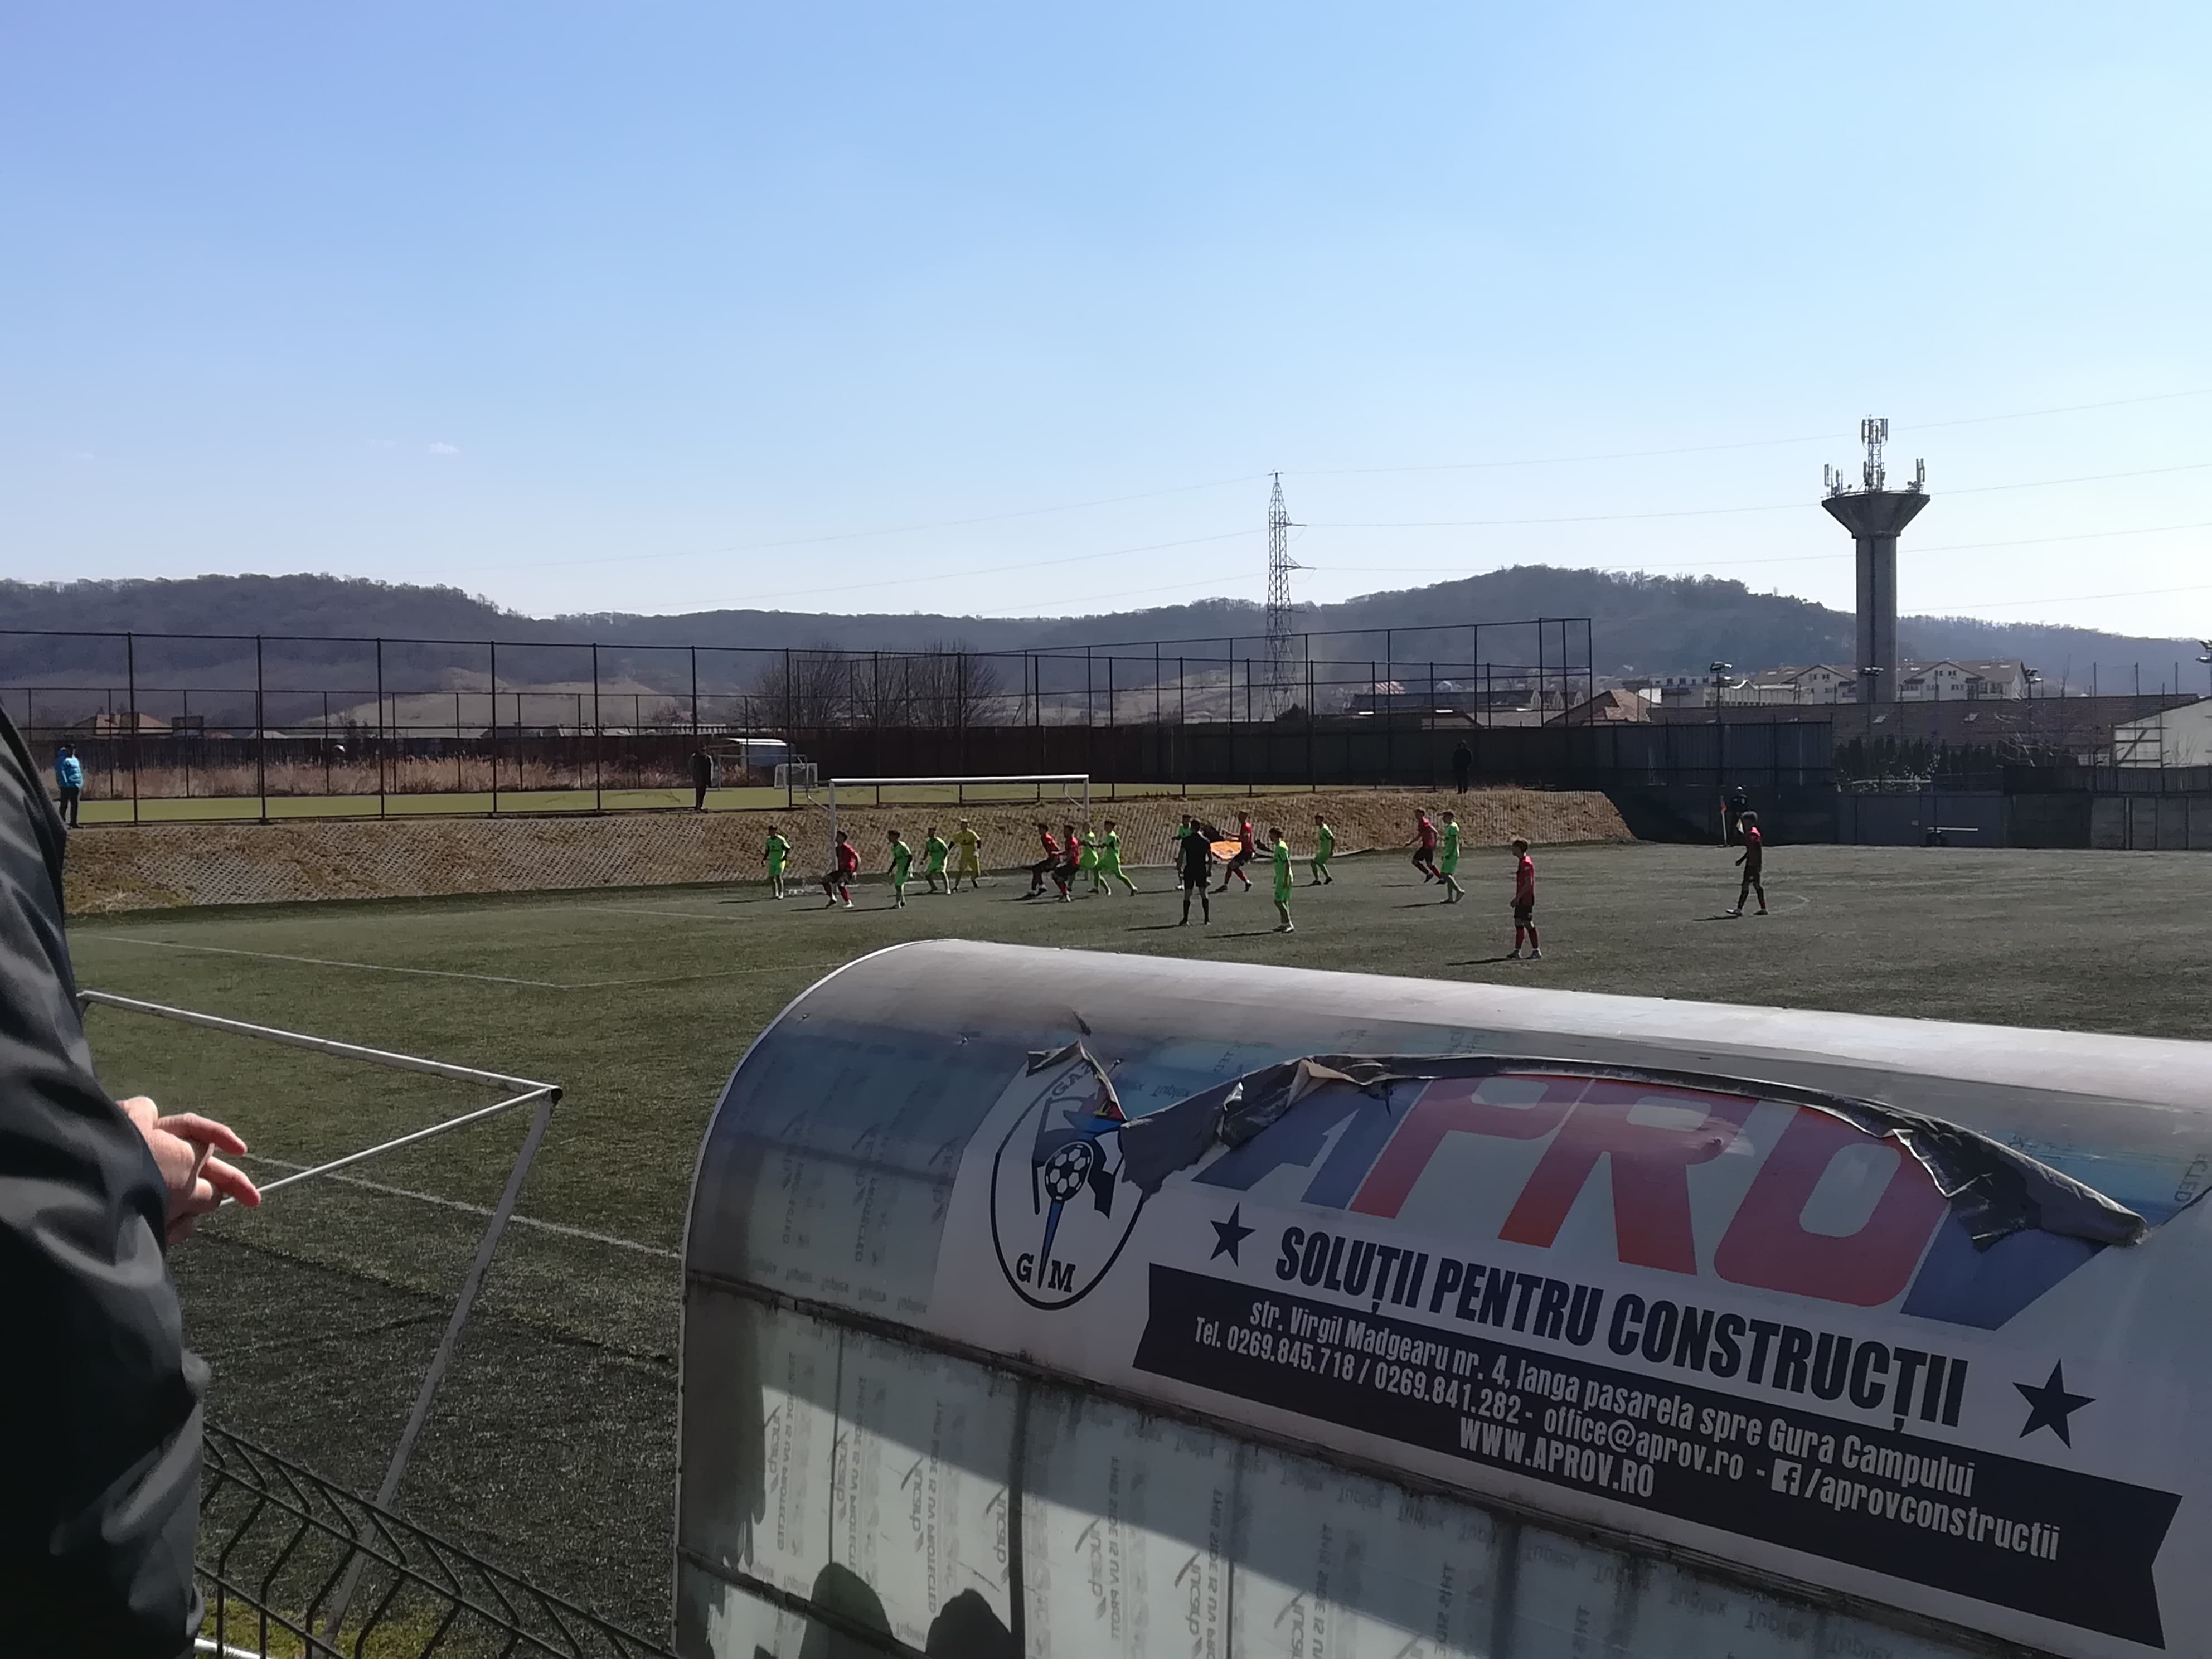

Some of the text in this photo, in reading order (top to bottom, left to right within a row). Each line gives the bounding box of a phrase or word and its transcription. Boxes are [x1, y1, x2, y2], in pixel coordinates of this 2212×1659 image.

[1015, 1251, 1076, 1294] G M
[1428, 1258, 1604, 1346] PENTRU
[1194, 1316, 1221, 1348] Tel.
[1226, 1324, 1355, 1381] 0269.845.718
[1374, 1361, 1522, 1425] 0269.841.282
[1543, 1408, 1744, 1481] office@aprov.ro
[1249, 1299, 1976, 1498] str. Virgil Madgearu nr. 4, langa pasarela spre Gura Campului
[1459, 1416, 1656, 1498] WWW.APROV.RO
